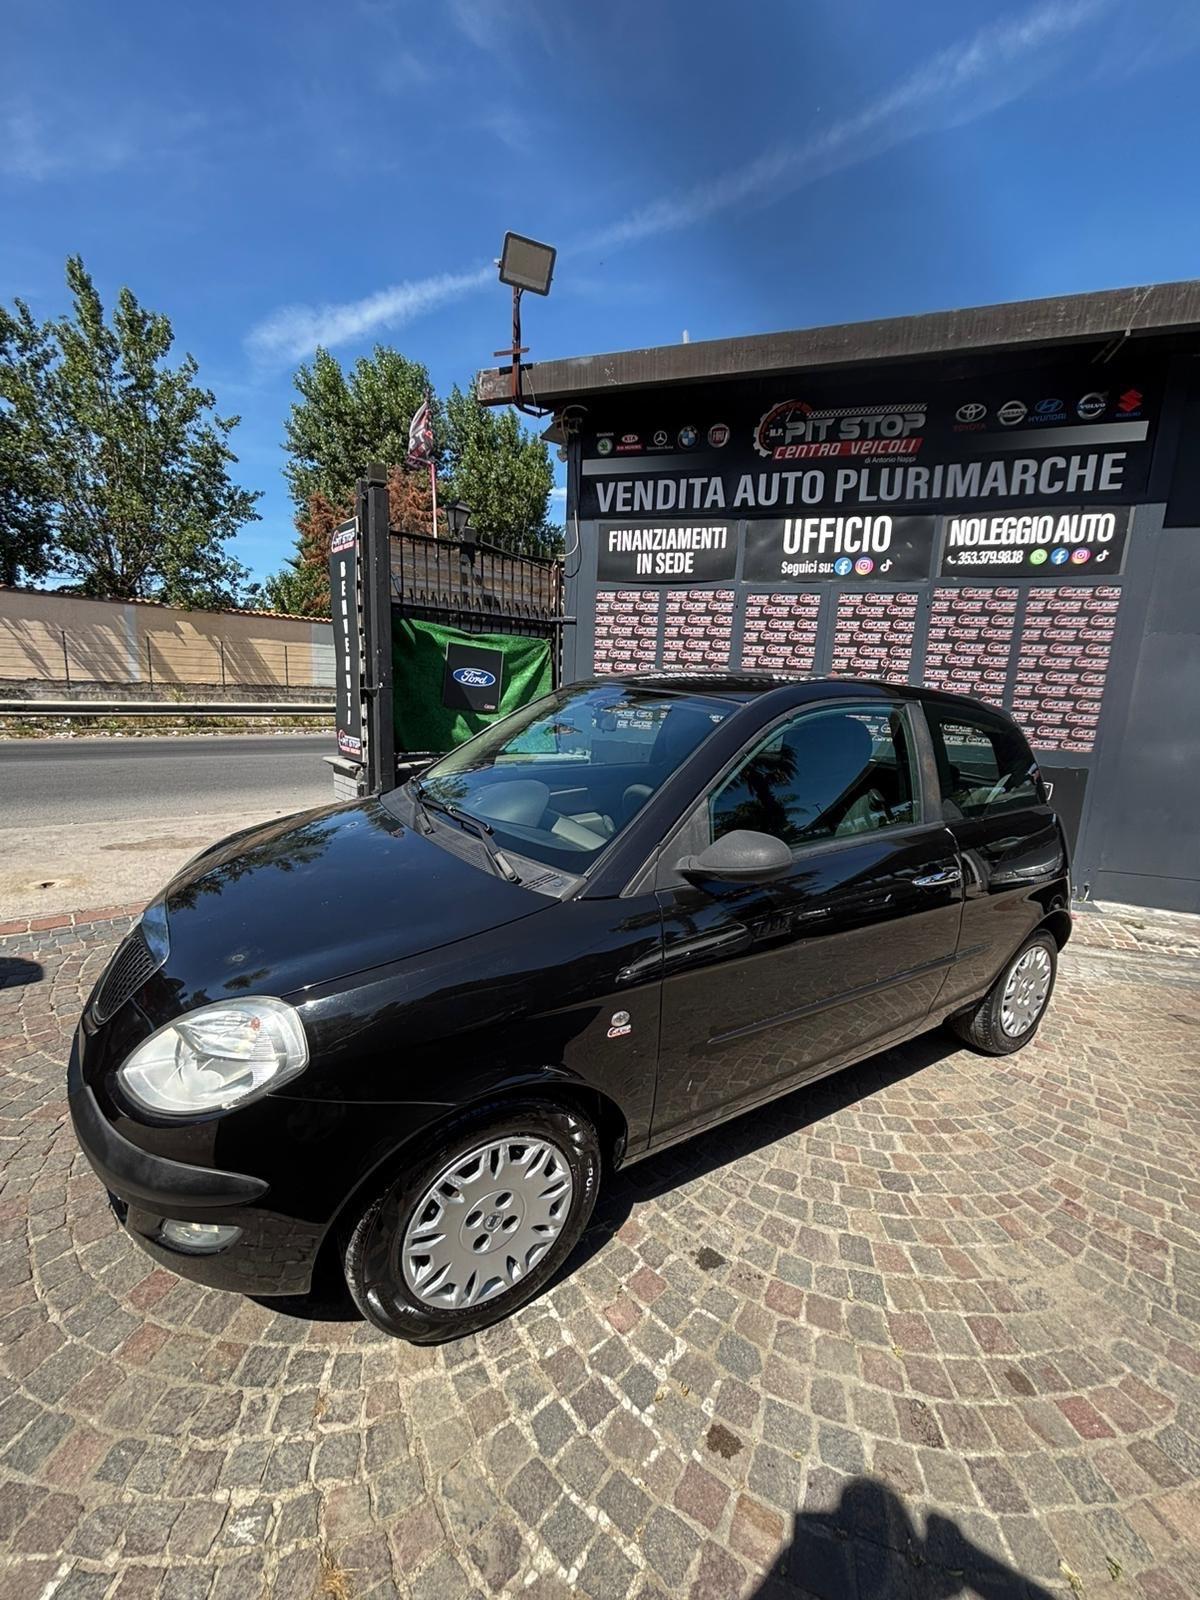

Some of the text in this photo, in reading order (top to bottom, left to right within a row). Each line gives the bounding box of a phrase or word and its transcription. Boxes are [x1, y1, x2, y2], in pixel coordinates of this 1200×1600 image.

[784, 417, 835, 444] PIT
[838, 413, 926, 440] STOP
[596, 452, 1128, 513] VENDITA AUTO PLURIMARCHE
[608, 526, 728, 552] FINANZIAMENTI
[783, 515, 893, 555] UFFICIO
[949, 513, 1116, 547] NOLEGGIO AUTO
[636, 551, 695, 575] IN SEDE
[781, 560, 834, 577] Seguici su:
[460, 670, 489, 684] Ford
